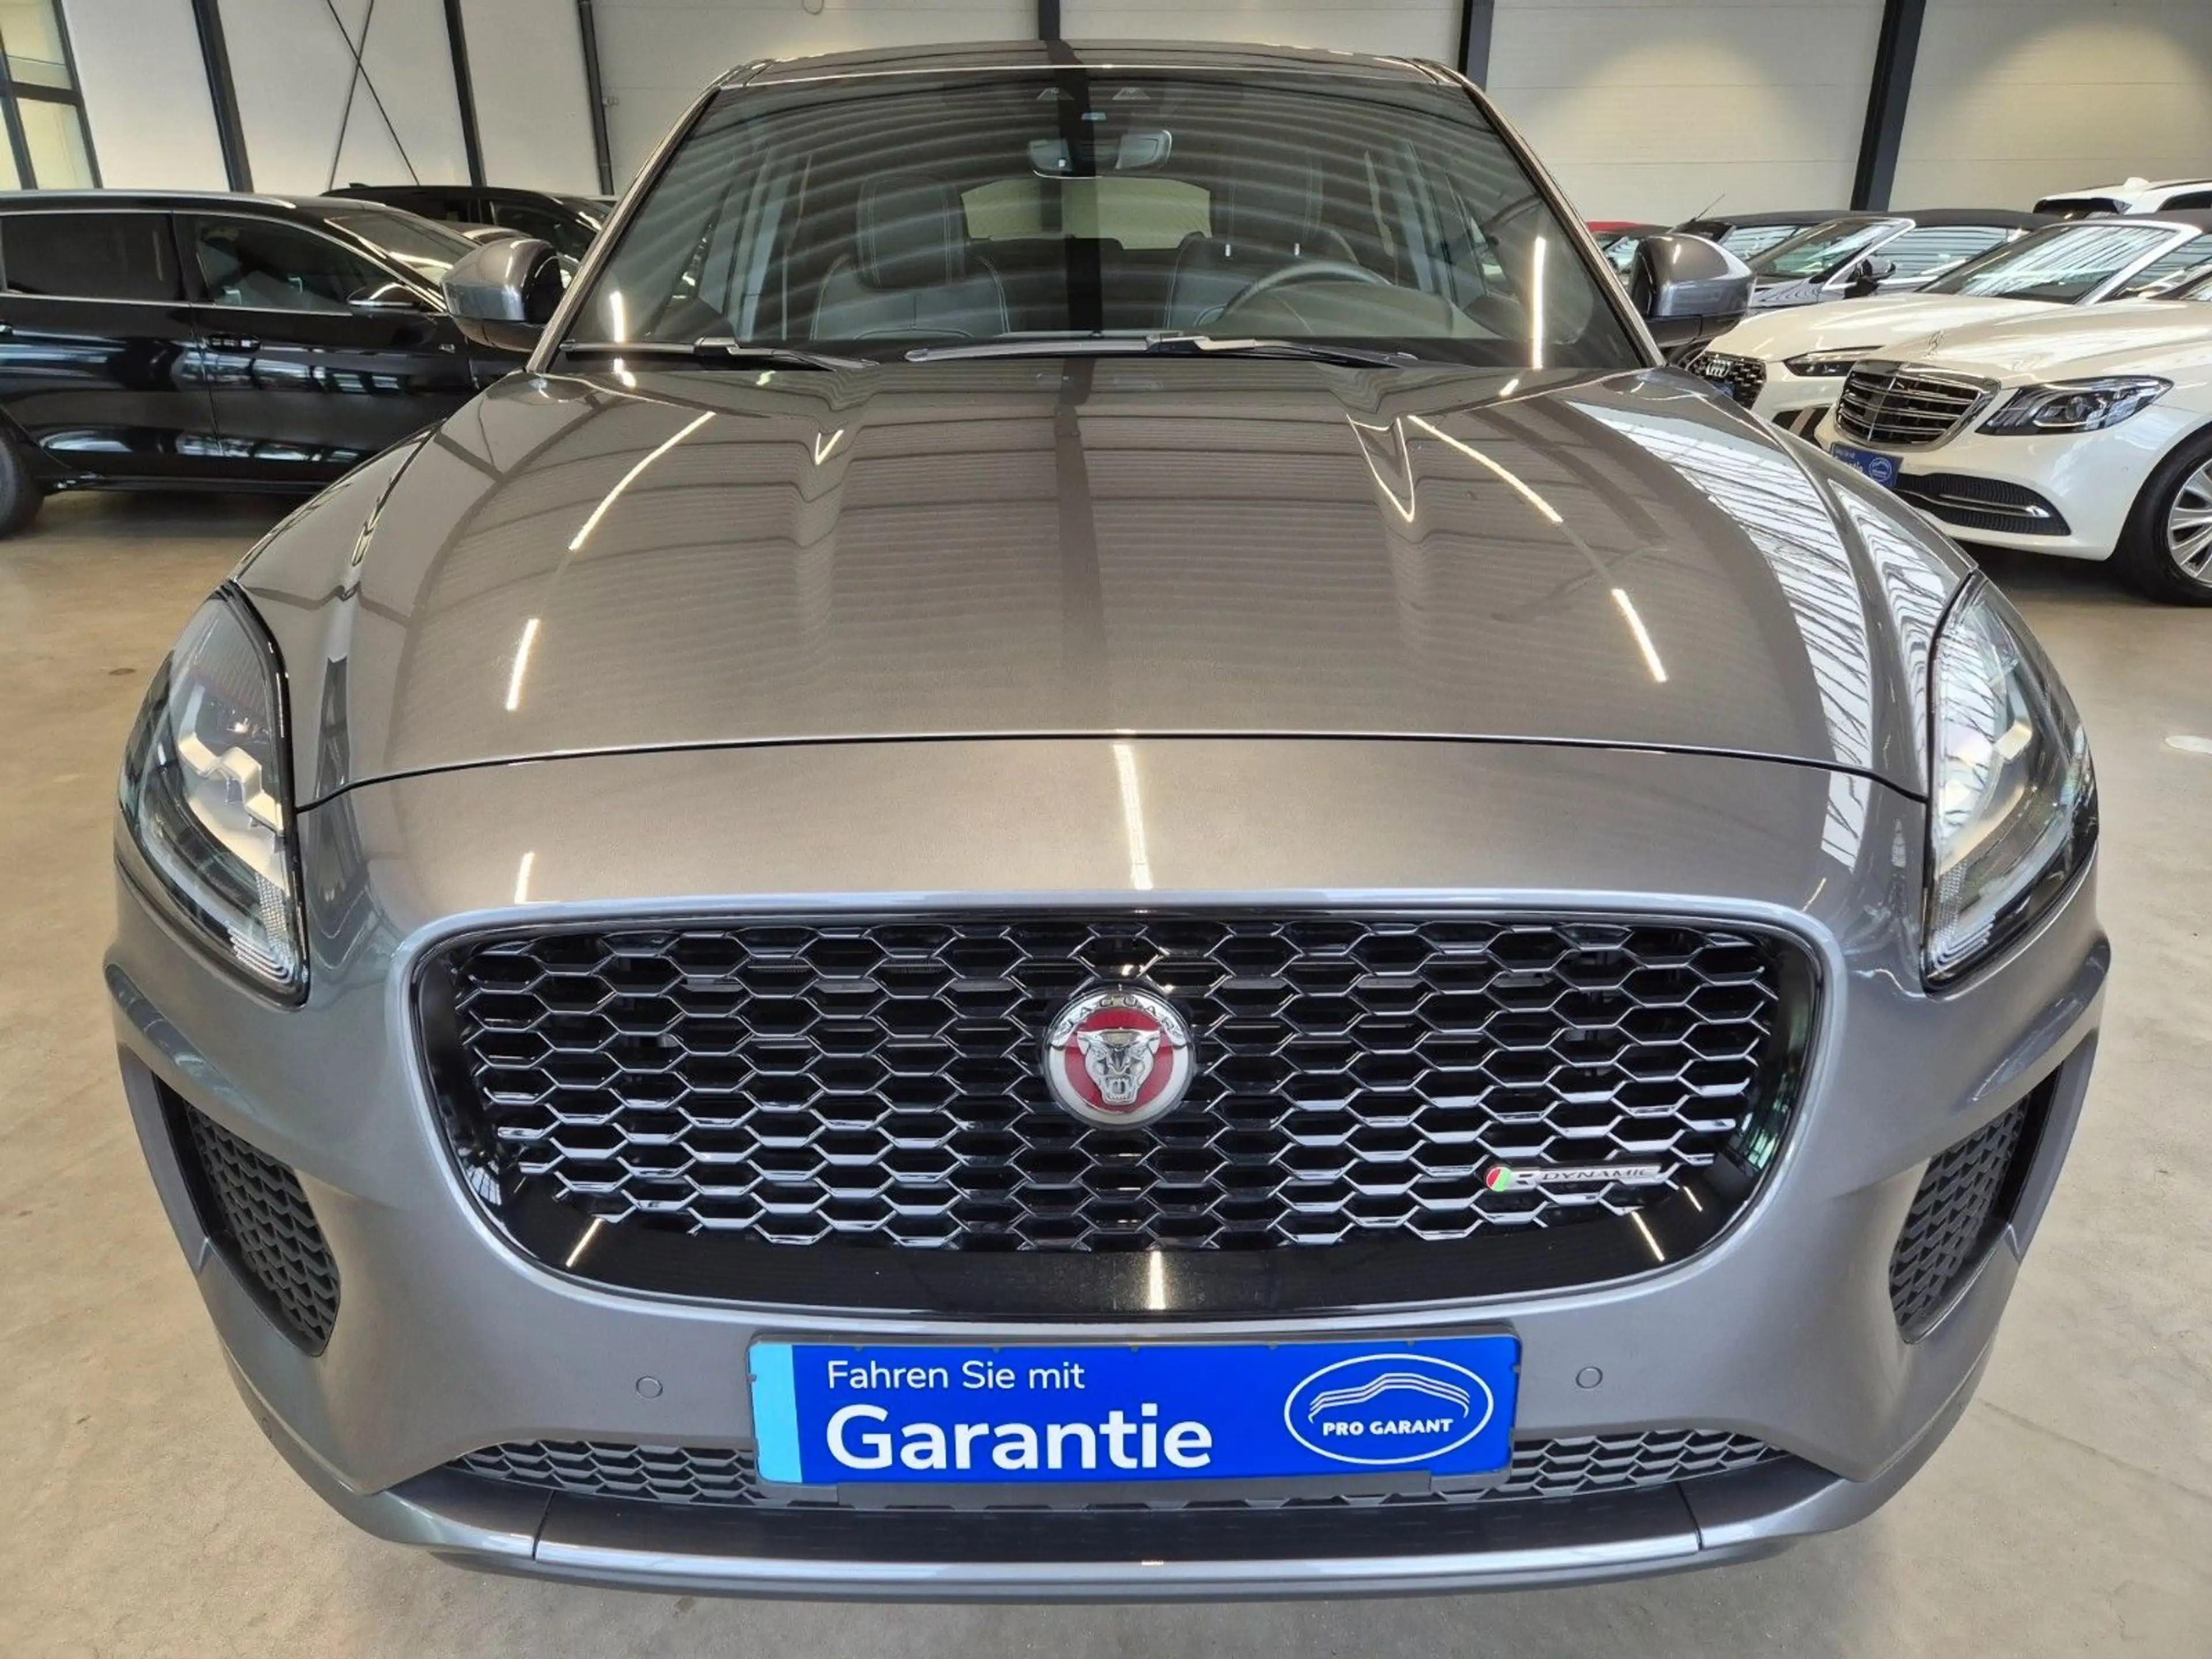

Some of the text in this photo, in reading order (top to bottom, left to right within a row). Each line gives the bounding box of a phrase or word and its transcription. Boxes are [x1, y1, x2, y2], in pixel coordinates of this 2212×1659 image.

[1060, 996, 1176, 1031] JAGUAR
[828, 1360, 1085, 1389] Fahren Sie mit
[826, 1402, 1213, 1470] Garantie
[1323, 1418, 1454, 1435] PRO GARANT
